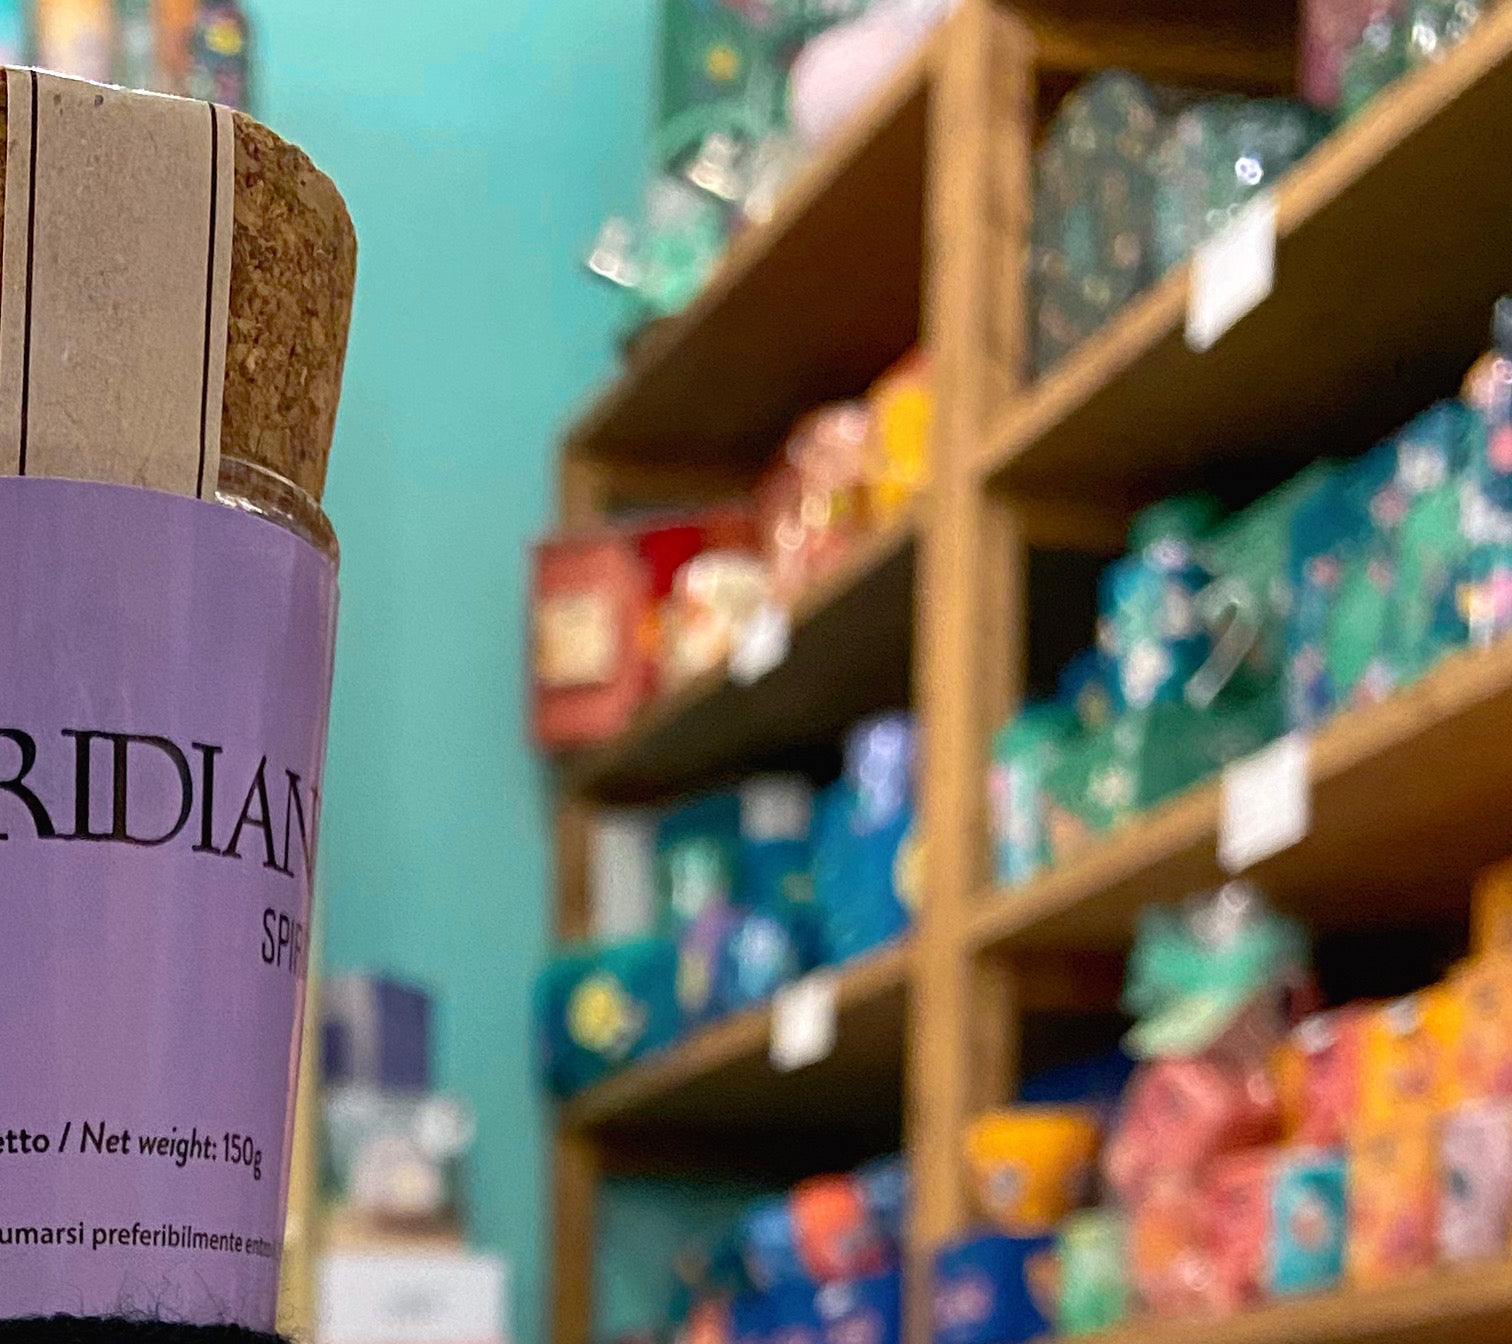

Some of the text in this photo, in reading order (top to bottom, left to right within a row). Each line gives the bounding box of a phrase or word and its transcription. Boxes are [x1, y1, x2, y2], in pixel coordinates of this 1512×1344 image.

[58, 1121, 72, 1153] /
[79, 1120, 132, 1155] Net
[138, 1126, 217, 1168] weight:
[223, 1132, 262, 1181] 150g
[92, 1221, 243, 1253] preferibilmente
